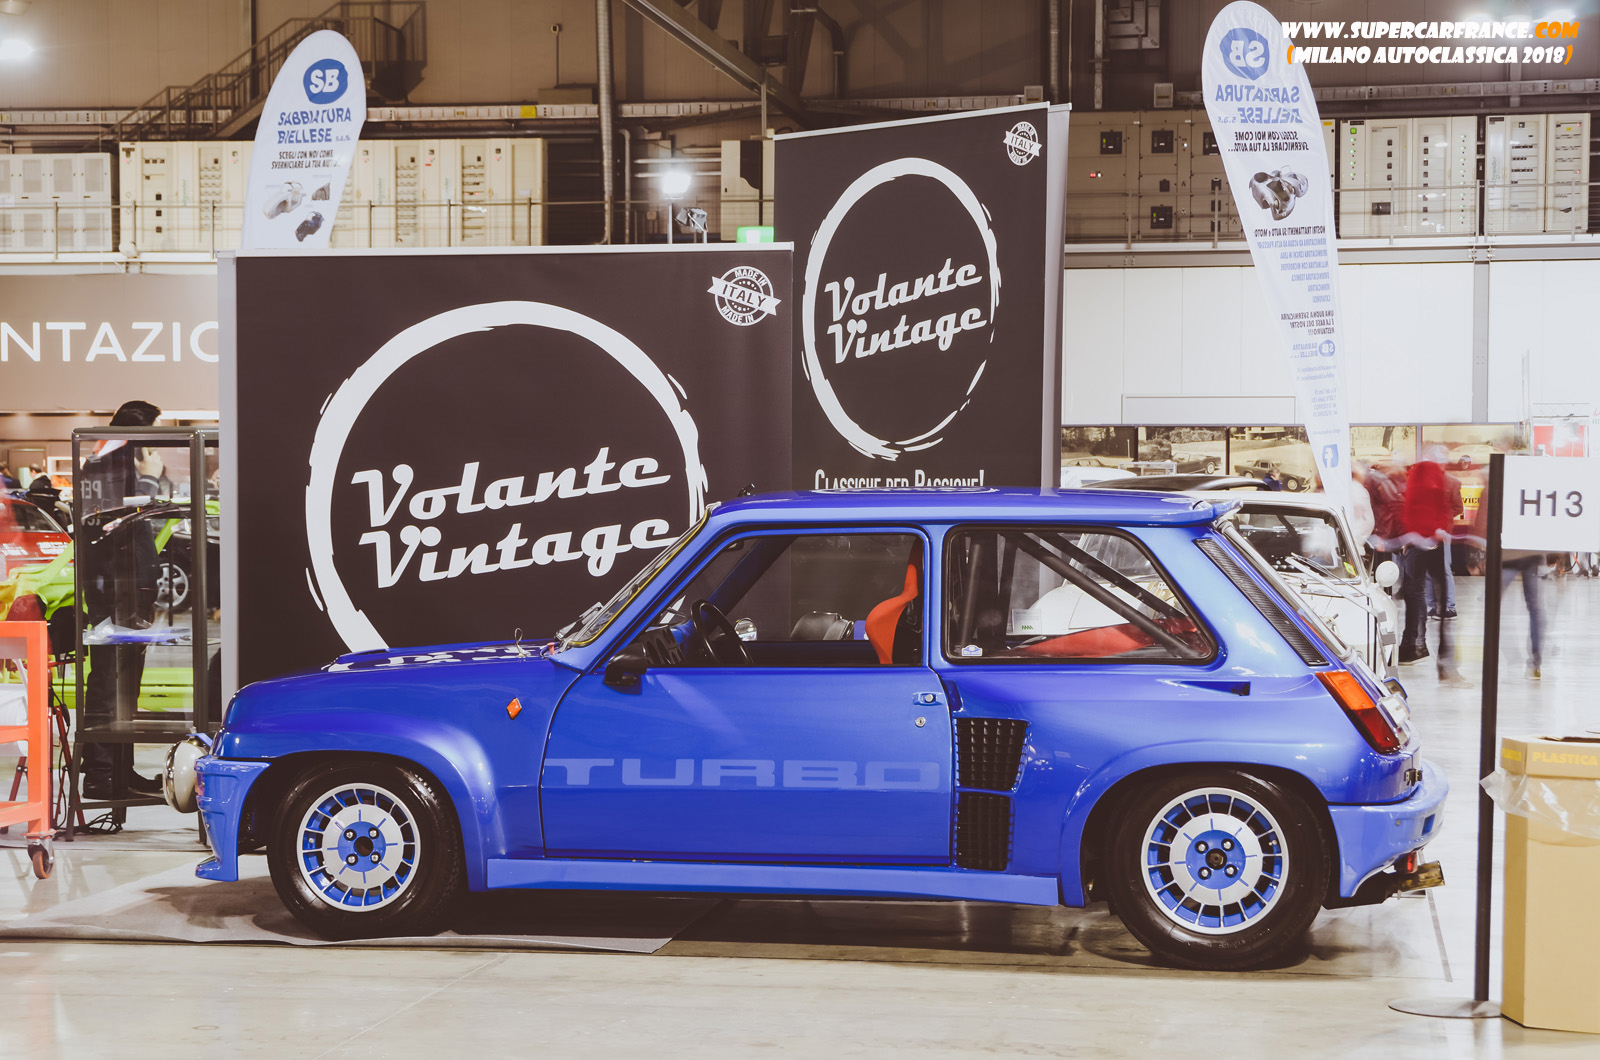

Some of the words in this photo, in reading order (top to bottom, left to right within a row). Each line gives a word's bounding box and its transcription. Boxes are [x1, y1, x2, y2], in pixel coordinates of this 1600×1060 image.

[309, 69, 340, 94] SB
[278, 128, 332, 144] BIELLESE
[1011, 135, 1034, 150] ITALY
[297, 150, 307, 159] CON
[308, 150, 318, 158] NOI
[319, 149, 333, 158] COME
[734, 269, 759, 280] MADE
[758, 276, 768, 287] IN
[824, 257, 983, 322] Volante
[722, 284, 766, 307] ITALY
[721, 305, 743, 323] MADE
[745, 314, 754, 323] IN
[826, 307, 987, 364] Vintage
[351, 446, 671, 527] Volante
[1519, 488, 1584, 518] H13
[358, 518, 682, 589] Vintage
[1532, 751, 1599, 766] PLASTICA
[543, 758, 940, 790] TURBO
